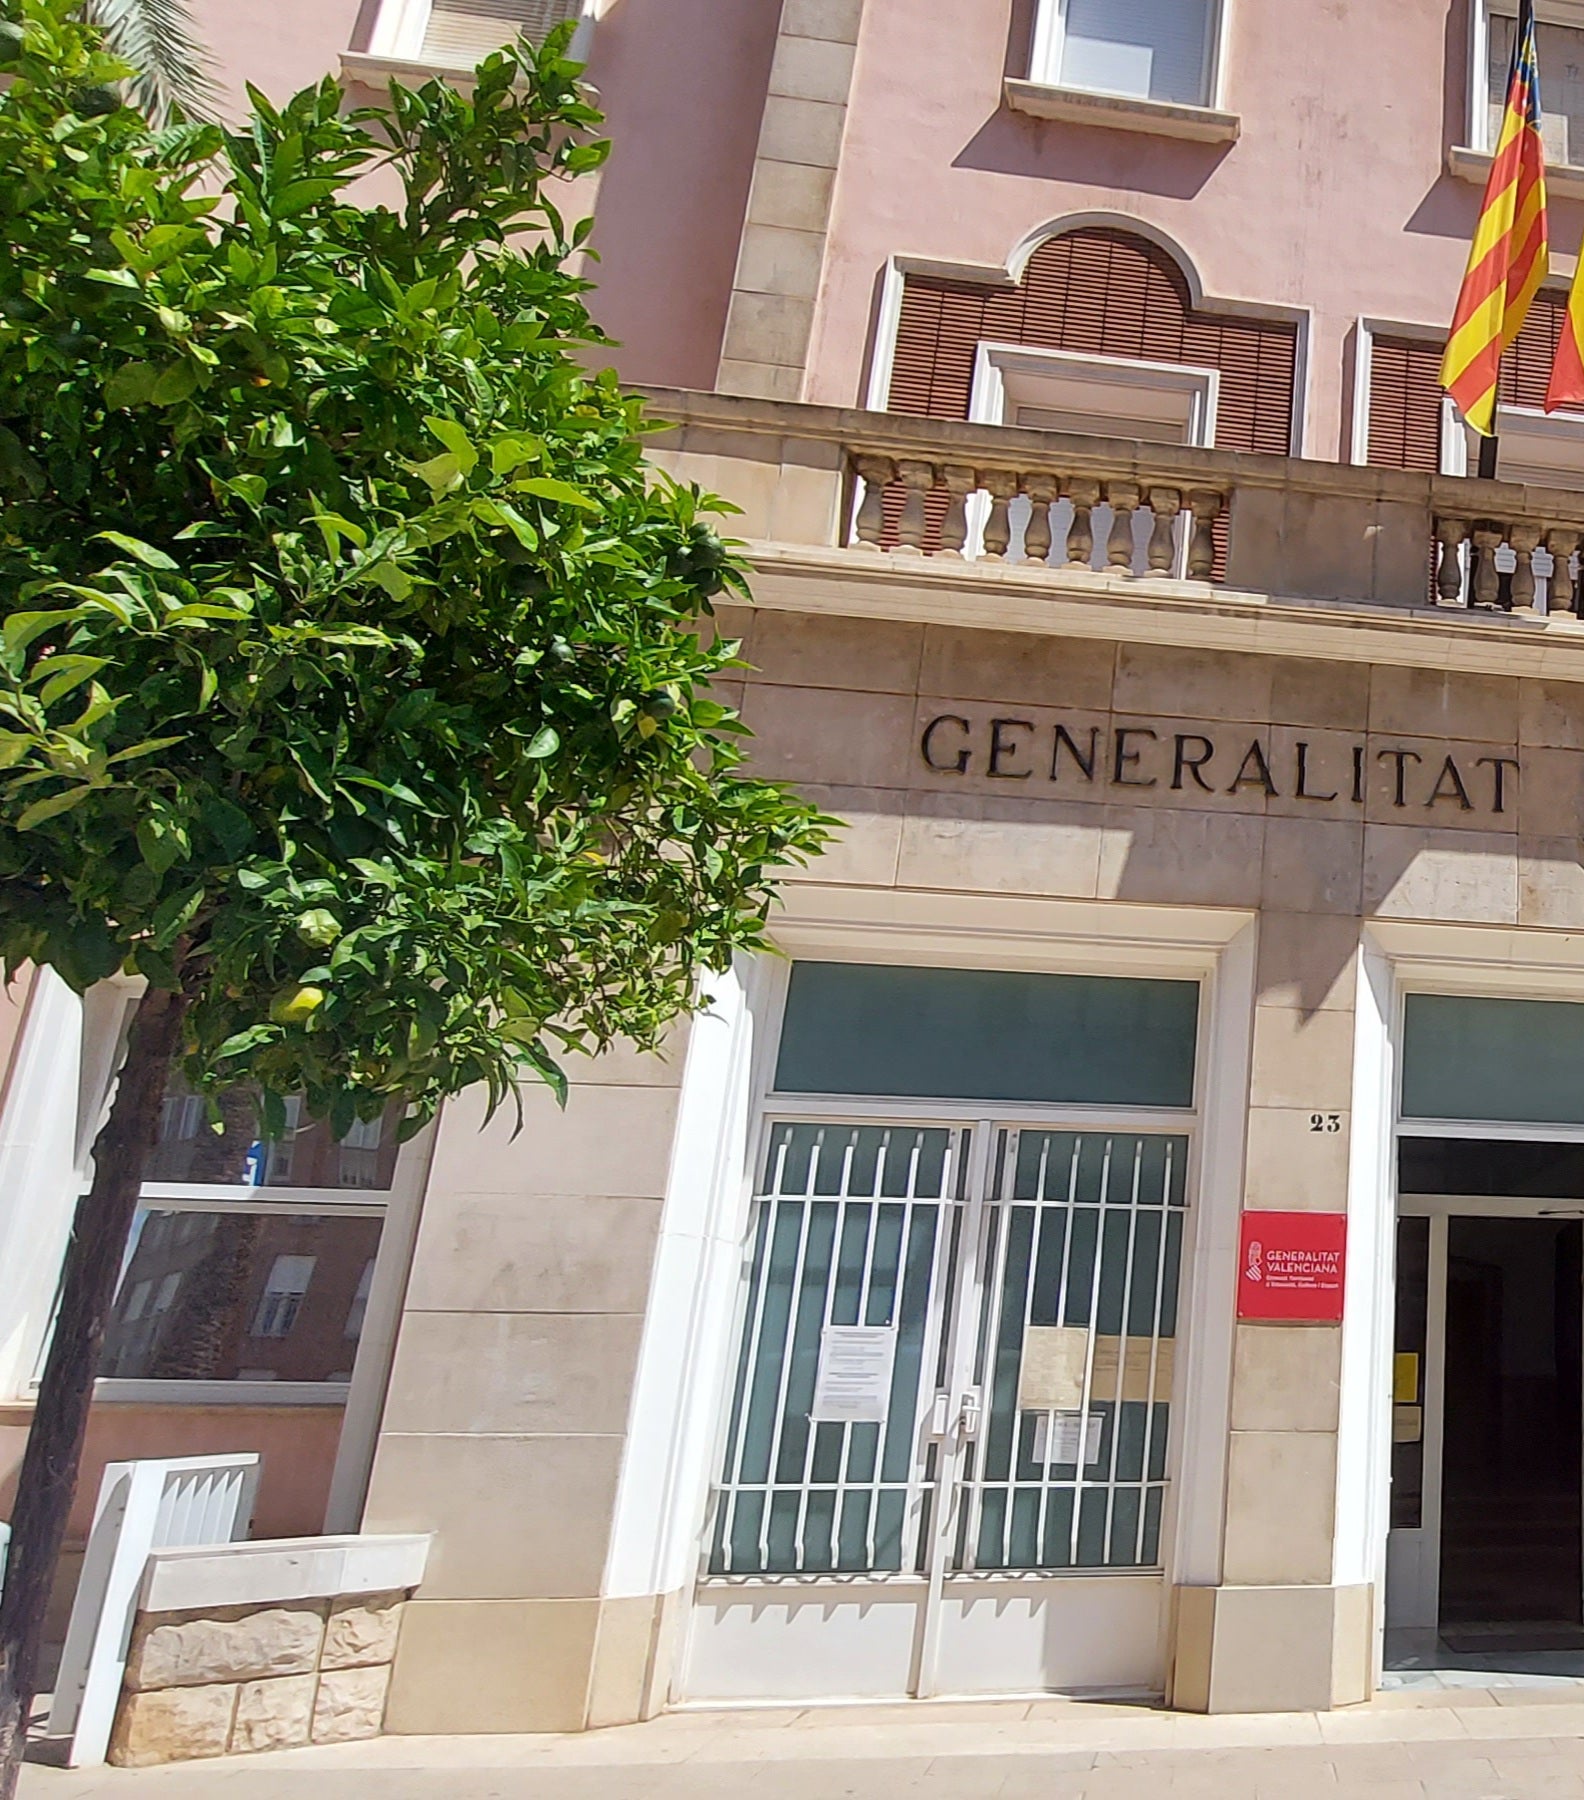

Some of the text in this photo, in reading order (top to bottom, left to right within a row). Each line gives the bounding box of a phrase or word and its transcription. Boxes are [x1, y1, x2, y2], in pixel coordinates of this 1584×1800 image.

[920, 714, 1518, 813] GENERALITAT
[1310, 1114, 1341, 1133] 23
[1266, 1250, 1341, 1263] GENERALITAT
[1266, 1262, 1338, 1273] VALENCIANA
